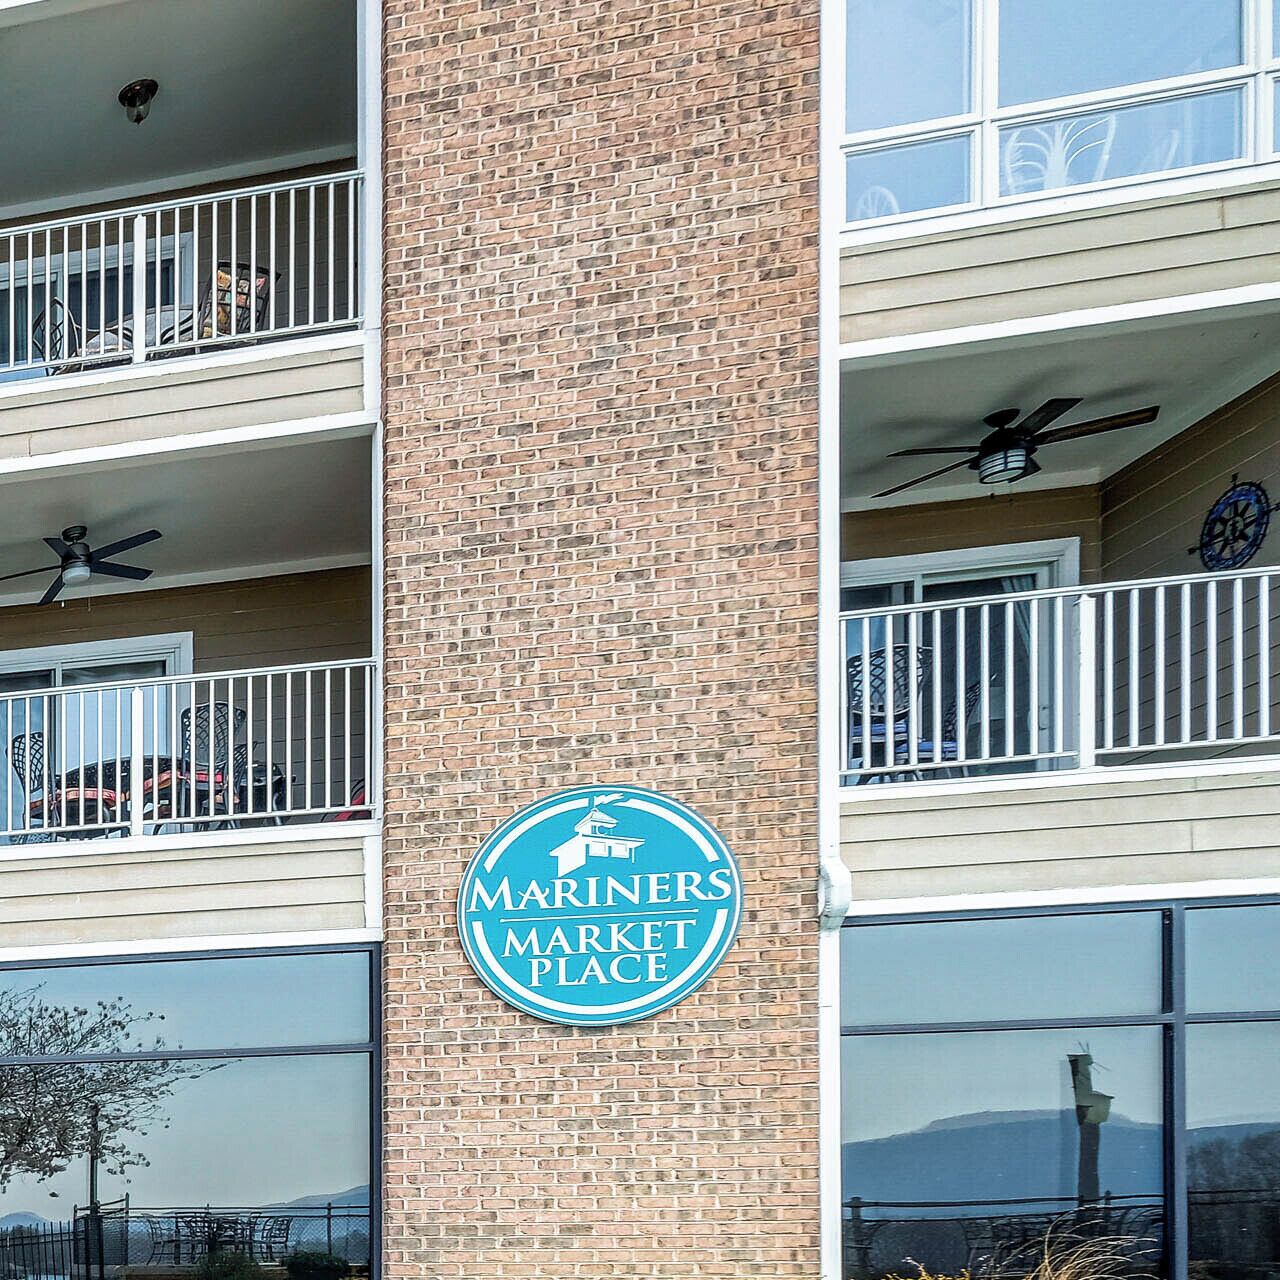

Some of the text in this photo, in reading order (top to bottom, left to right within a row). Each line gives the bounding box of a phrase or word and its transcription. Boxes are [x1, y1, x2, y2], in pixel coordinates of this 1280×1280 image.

[466, 868, 732, 913] MARINERS
[501, 919, 697, 958] MARKET
[528, 952, 669, 987] PLACE
